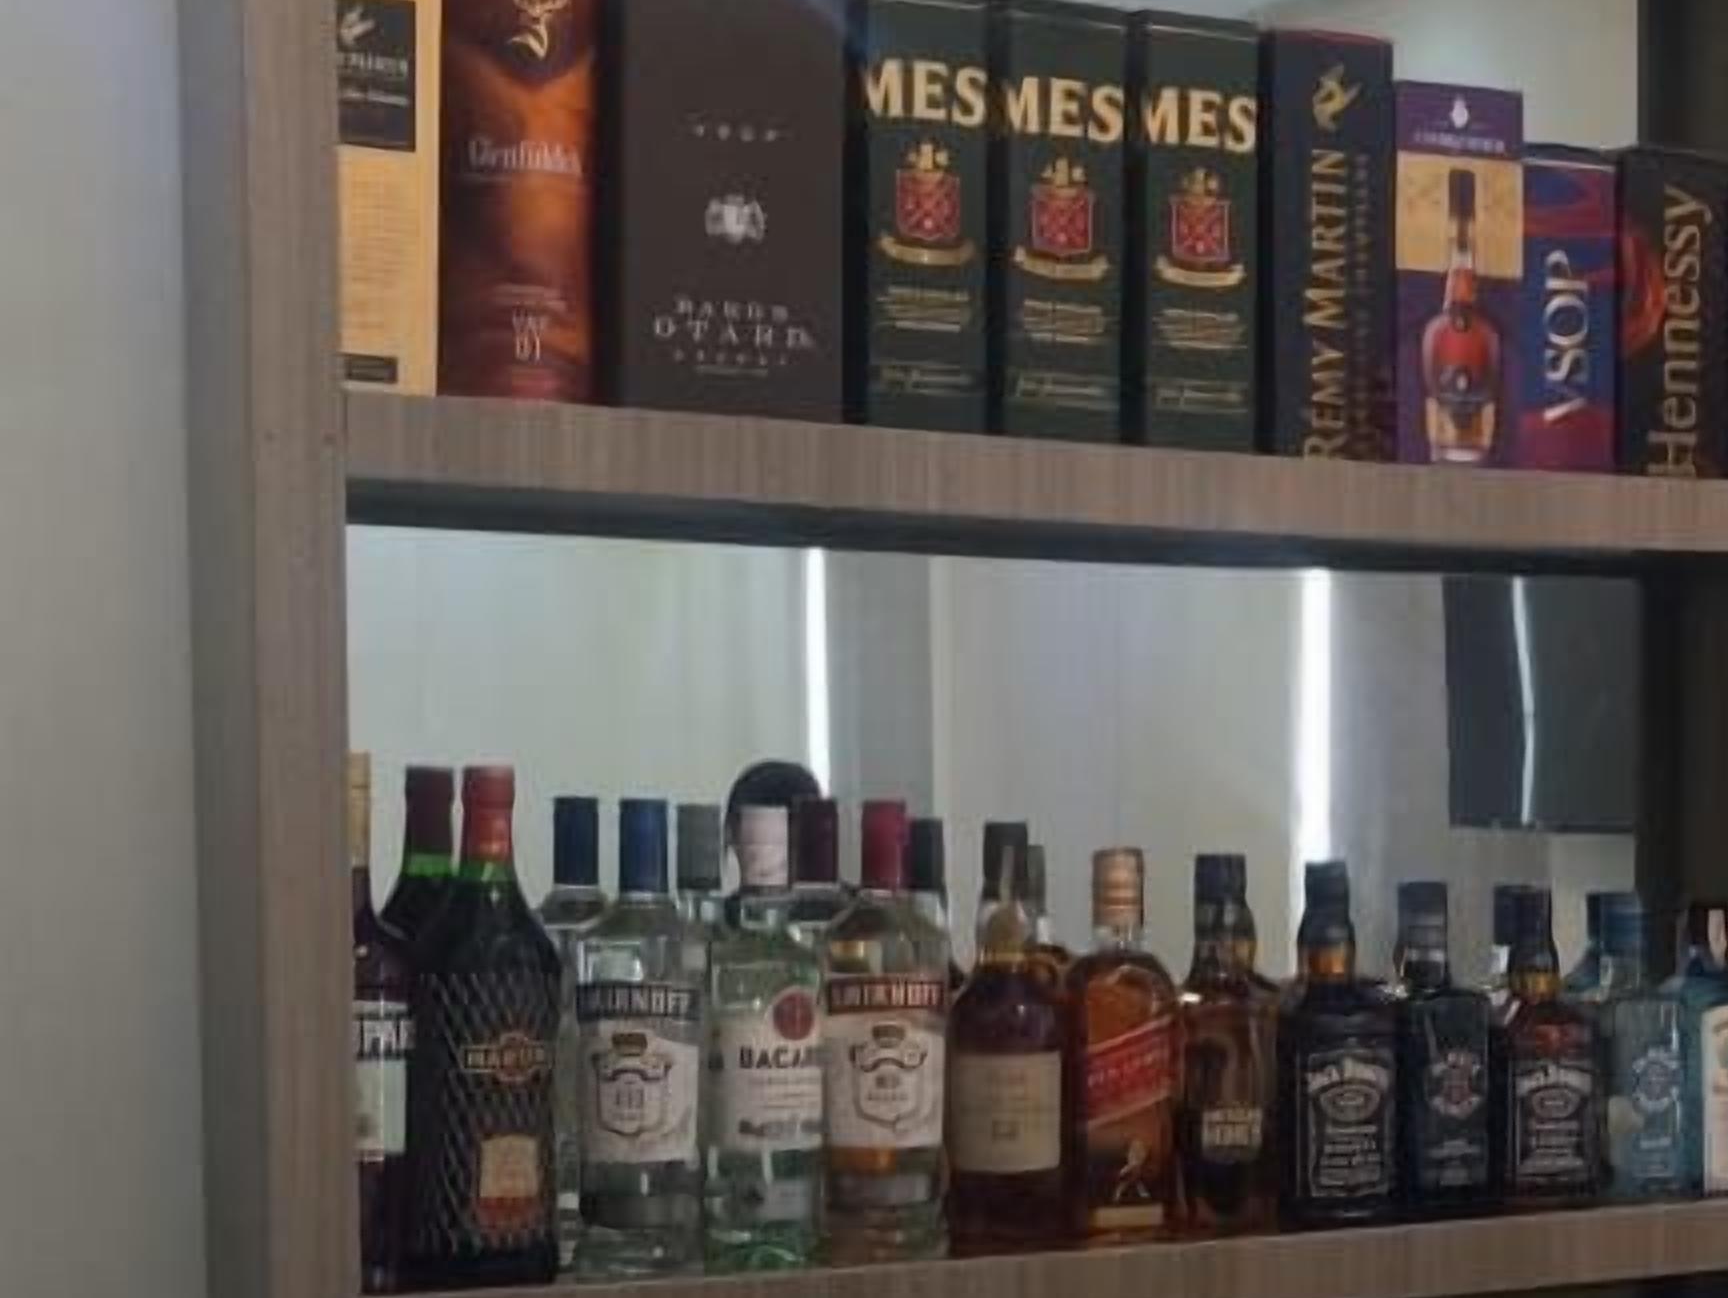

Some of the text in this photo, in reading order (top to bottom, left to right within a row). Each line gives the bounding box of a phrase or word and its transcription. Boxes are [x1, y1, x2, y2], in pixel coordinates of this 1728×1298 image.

[865, 58, 988, 129] MES
[1005, 75, 1125, 143] MES
[1143, 86, 1257, 154] MES
[1302, 148, 1347, 330] MARTIN
[1542, 249, 1589, 422] VSOP
[1646, 182, 1712, 479] Hennessy
